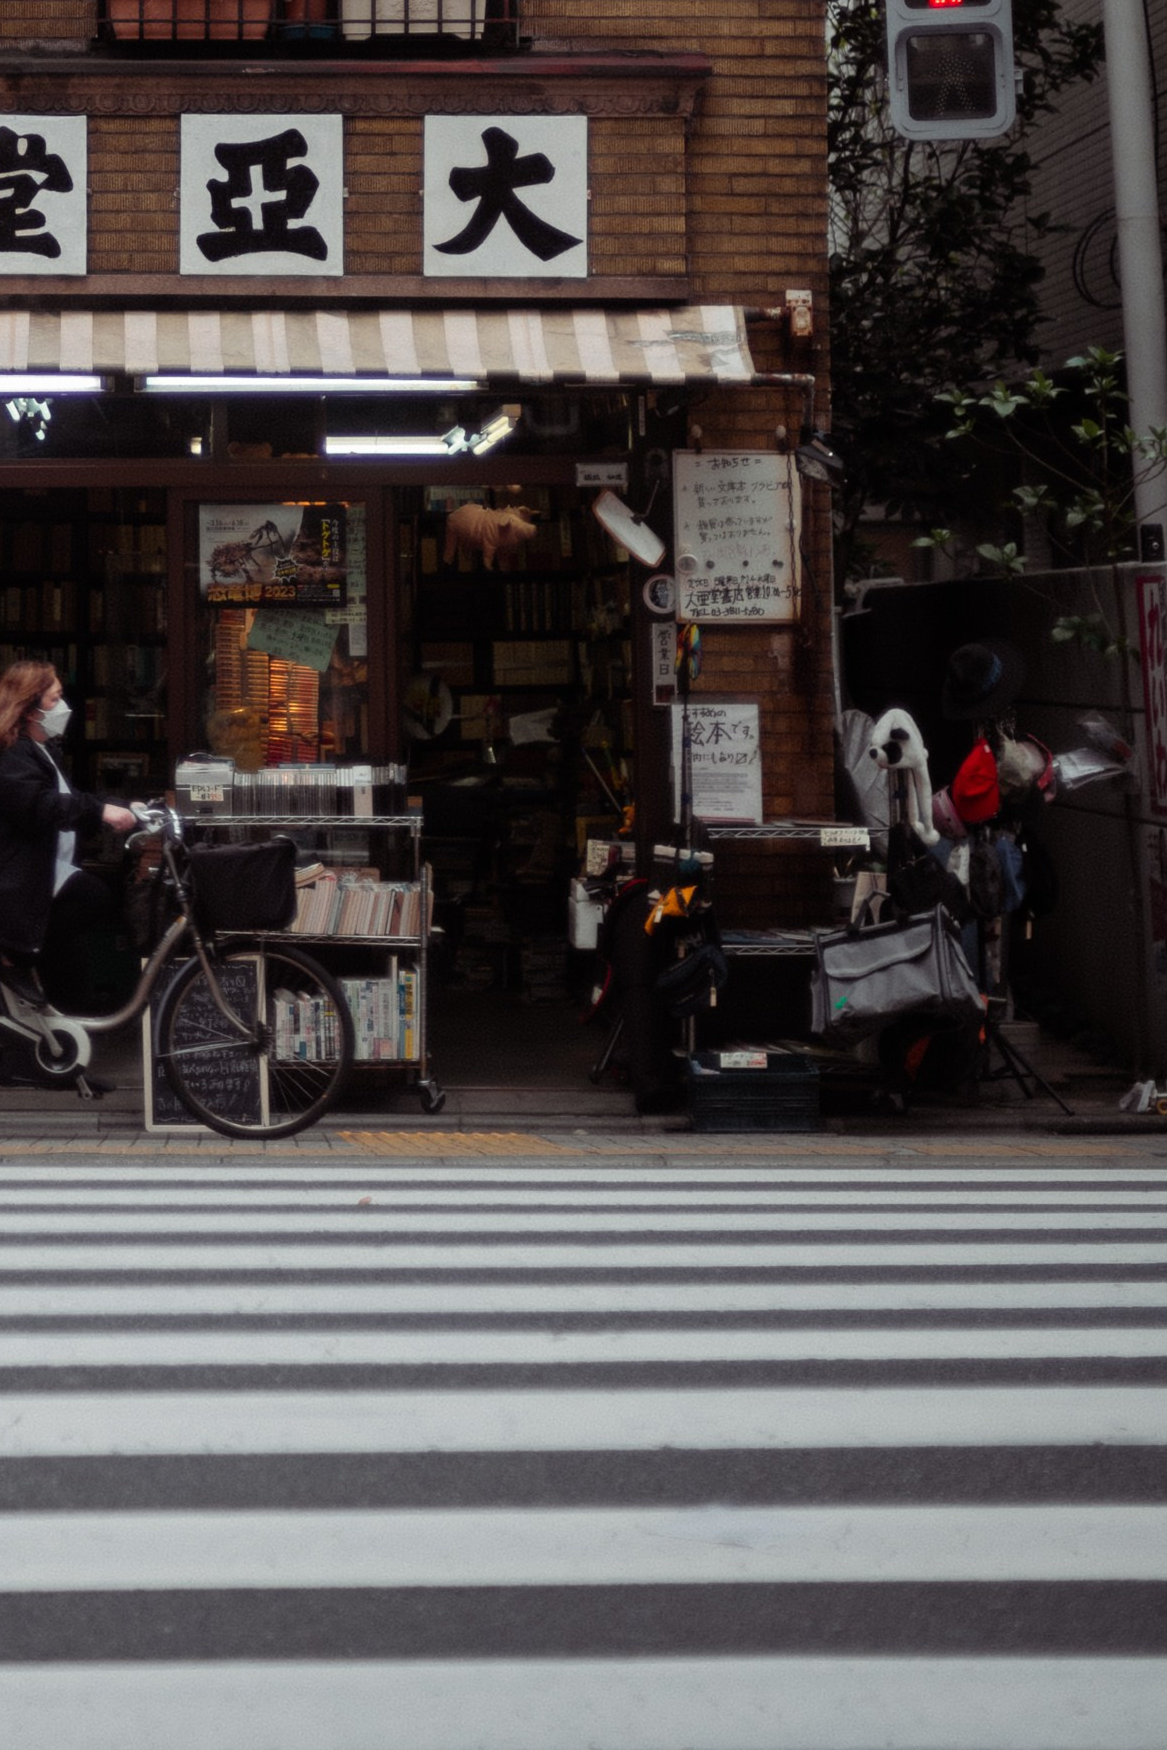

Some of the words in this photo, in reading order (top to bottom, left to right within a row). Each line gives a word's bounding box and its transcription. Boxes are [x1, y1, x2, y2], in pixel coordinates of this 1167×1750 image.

[265, 585, 296, 599] 2023
[658, 628, 672, 676] 営業日
